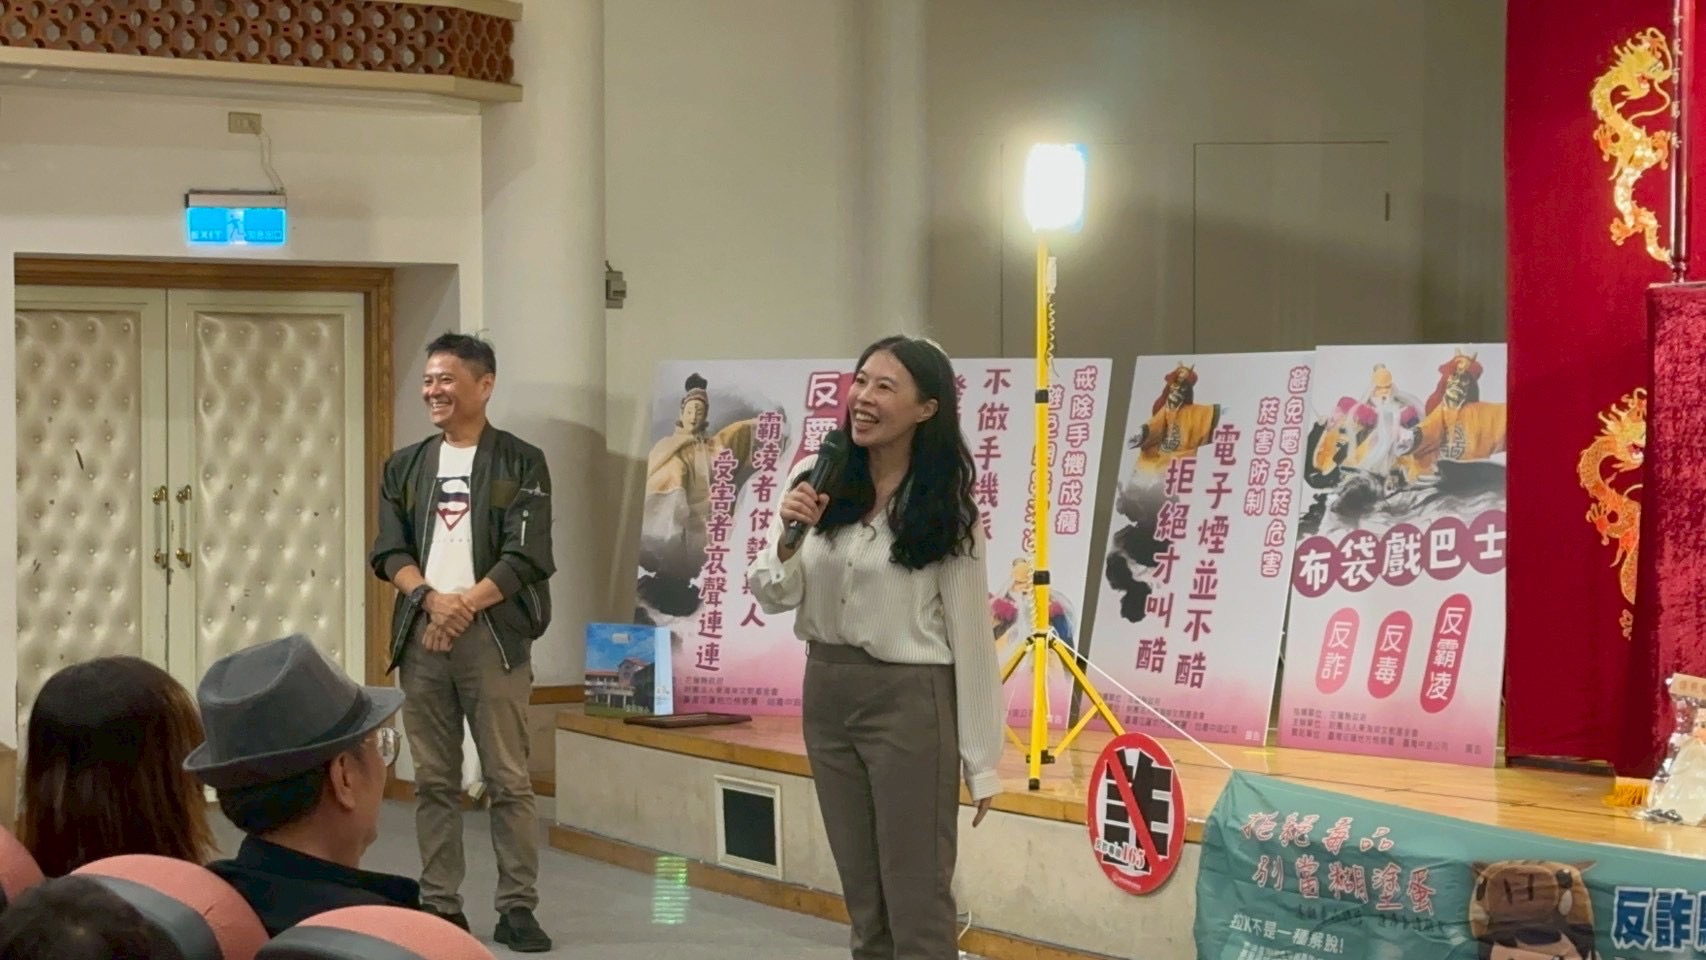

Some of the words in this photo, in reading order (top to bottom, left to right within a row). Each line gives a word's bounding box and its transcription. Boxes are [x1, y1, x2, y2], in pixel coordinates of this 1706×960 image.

[191, 230, 223, 239] EXIT
[1055, 365, 1098, 534] 戒除手機成癮
[1244, 397, 1281, 516] 菸害防制
[1261, 365, 1311, 578] 避免電子菸危害
[695, 450, 738, 672] 受害者哀聲連連
[740, 411, 782, 627] 霸凌者仗勢人
[1174, 424, 1240, 689] 電子煙並不酷
[1299, 524, 1507, 591] 布袋戲巴士
[1135, 459, 1197, 674] 拒絕才叫酷
[1321, 621, 1353, 680] 反詐
[1374, 624, 1406, 685] 反毒
[1425, 606, 1466, 700] 反霸凌
[1241, 811, 1394, 855] 拒絕毒品
[1252, 854, 1436, 915] 別當糊塗蛋
[1611, 886, 1706, 952] 反詐
